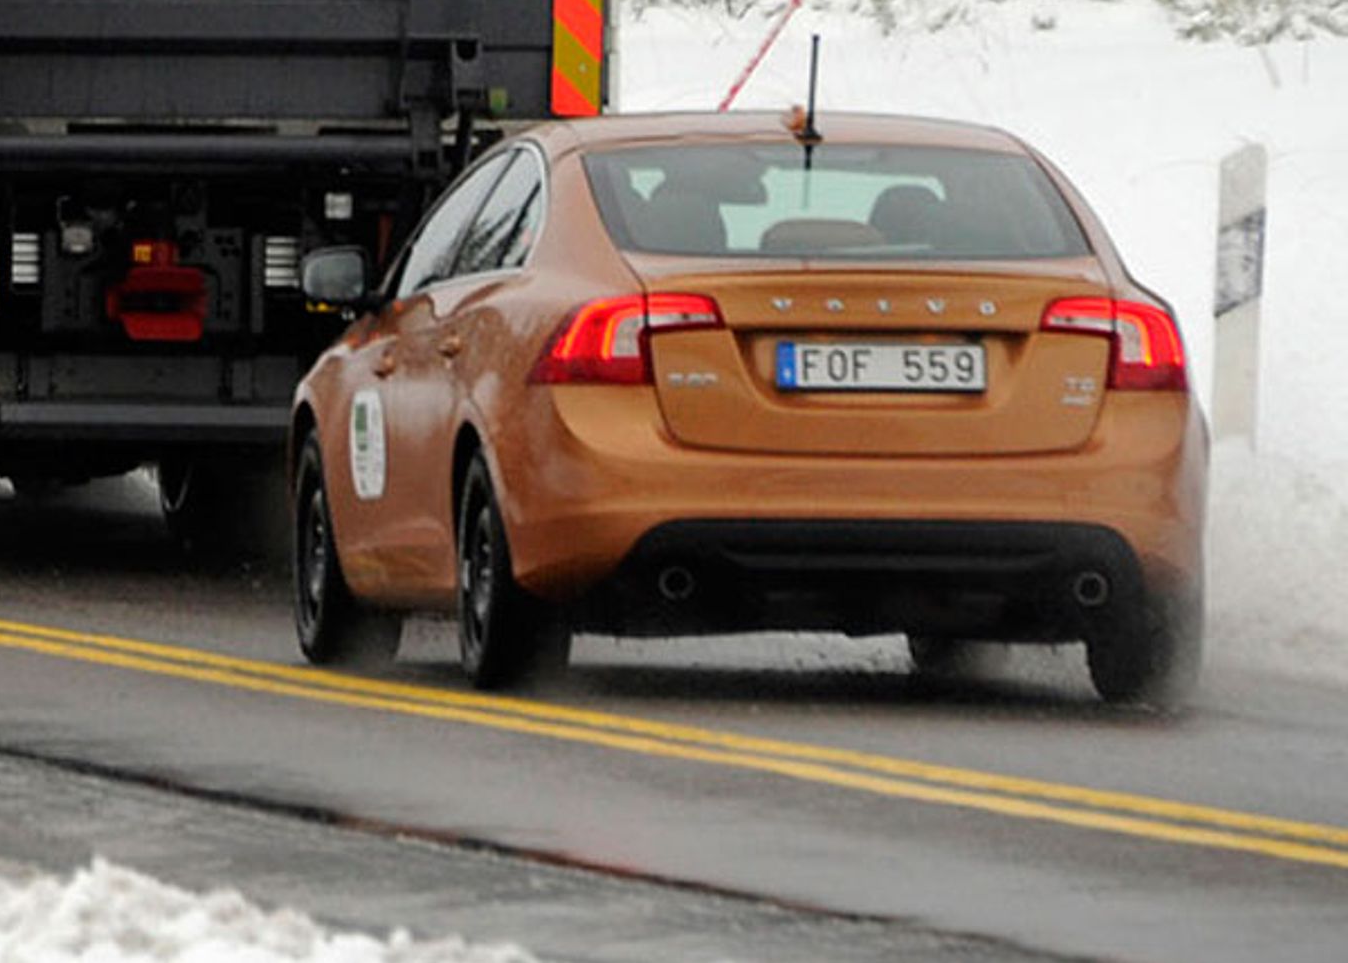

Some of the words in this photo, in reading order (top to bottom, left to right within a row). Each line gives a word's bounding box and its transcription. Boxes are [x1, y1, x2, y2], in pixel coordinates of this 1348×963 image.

[771, 296, 997, 317] VOLVO
[802, 349, 872, 382] FOF
[903, 350, 976, 383] 559
